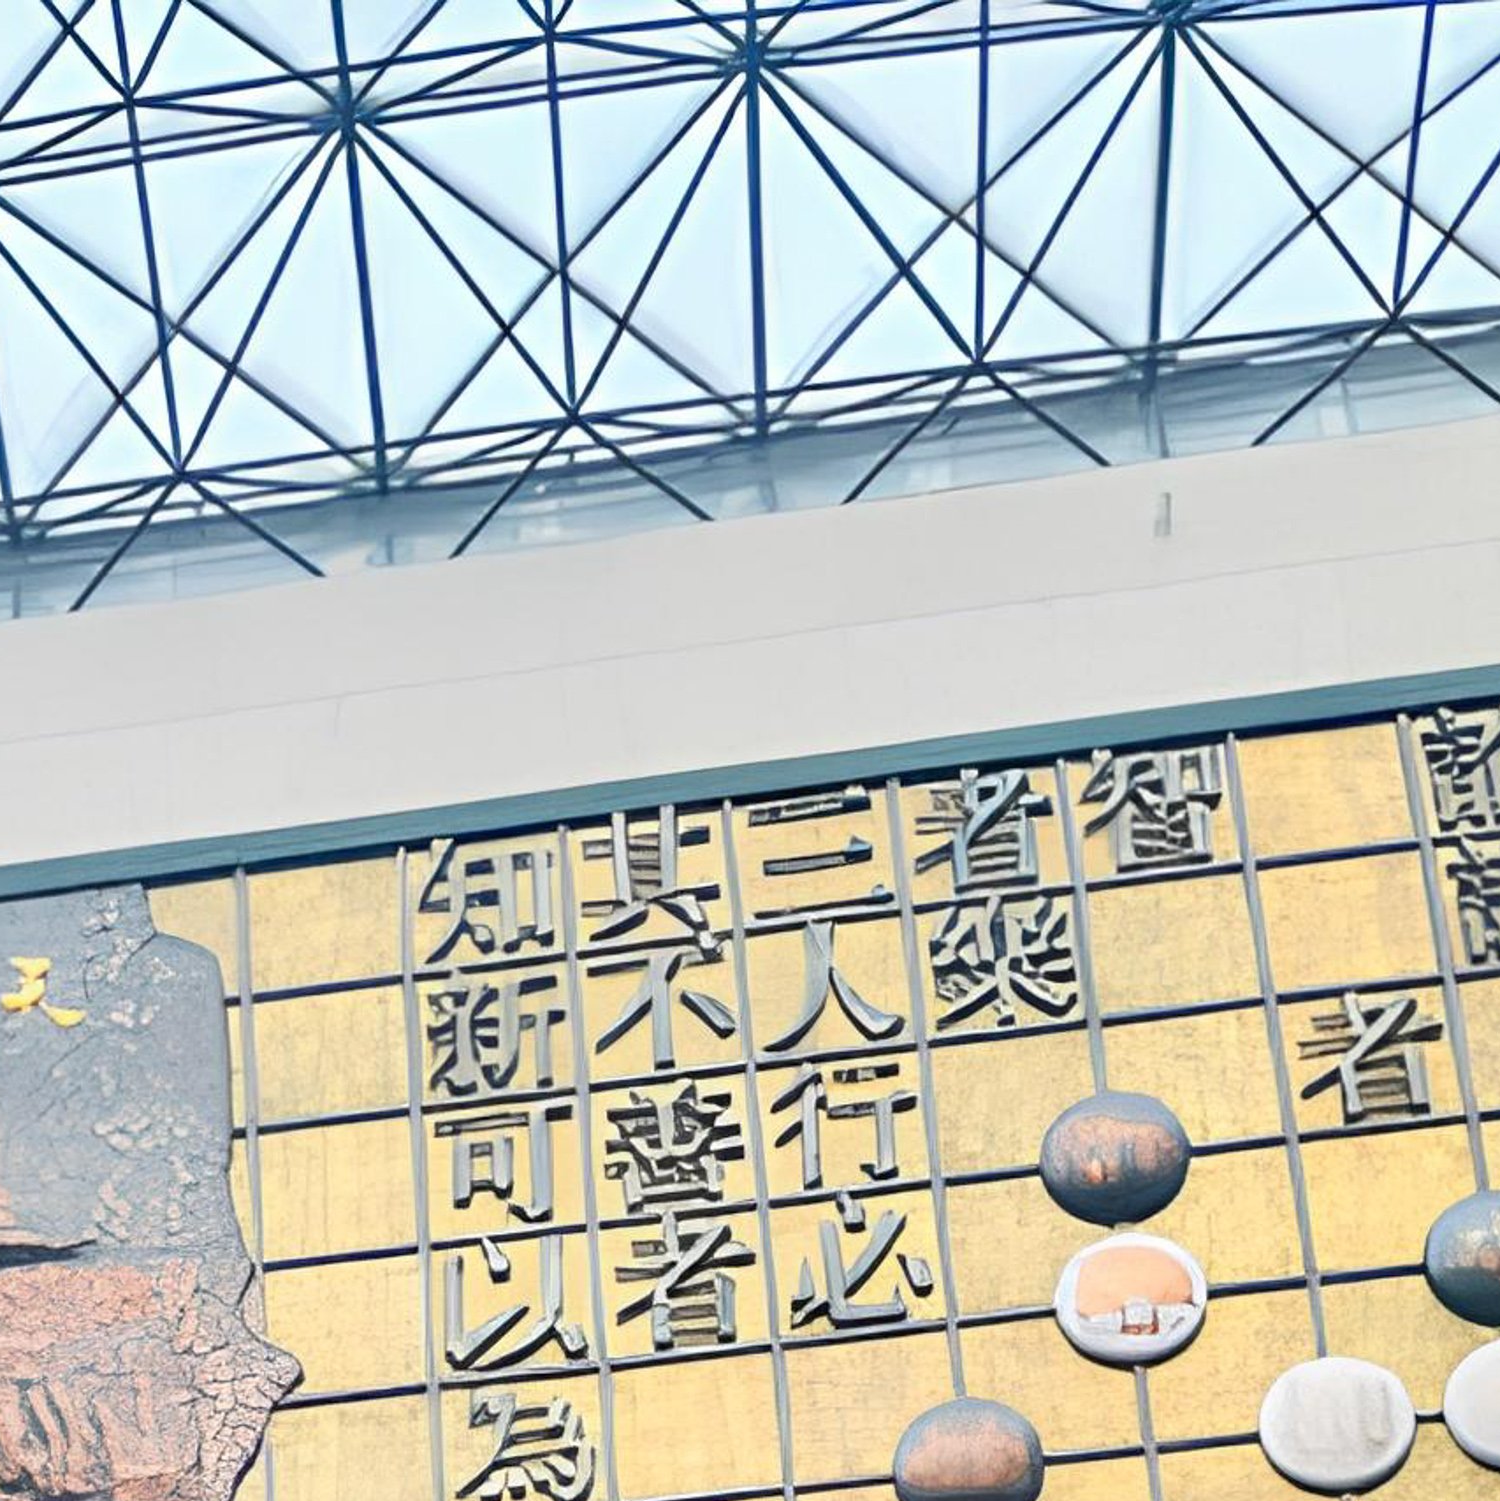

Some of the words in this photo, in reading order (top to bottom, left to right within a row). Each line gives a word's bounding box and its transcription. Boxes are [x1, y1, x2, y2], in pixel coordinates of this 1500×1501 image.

[1080, 749, 1226, 871] 智
[748, 786, 933, 1329] 三人行必
[1297, 990, 1444, 1123] 者
